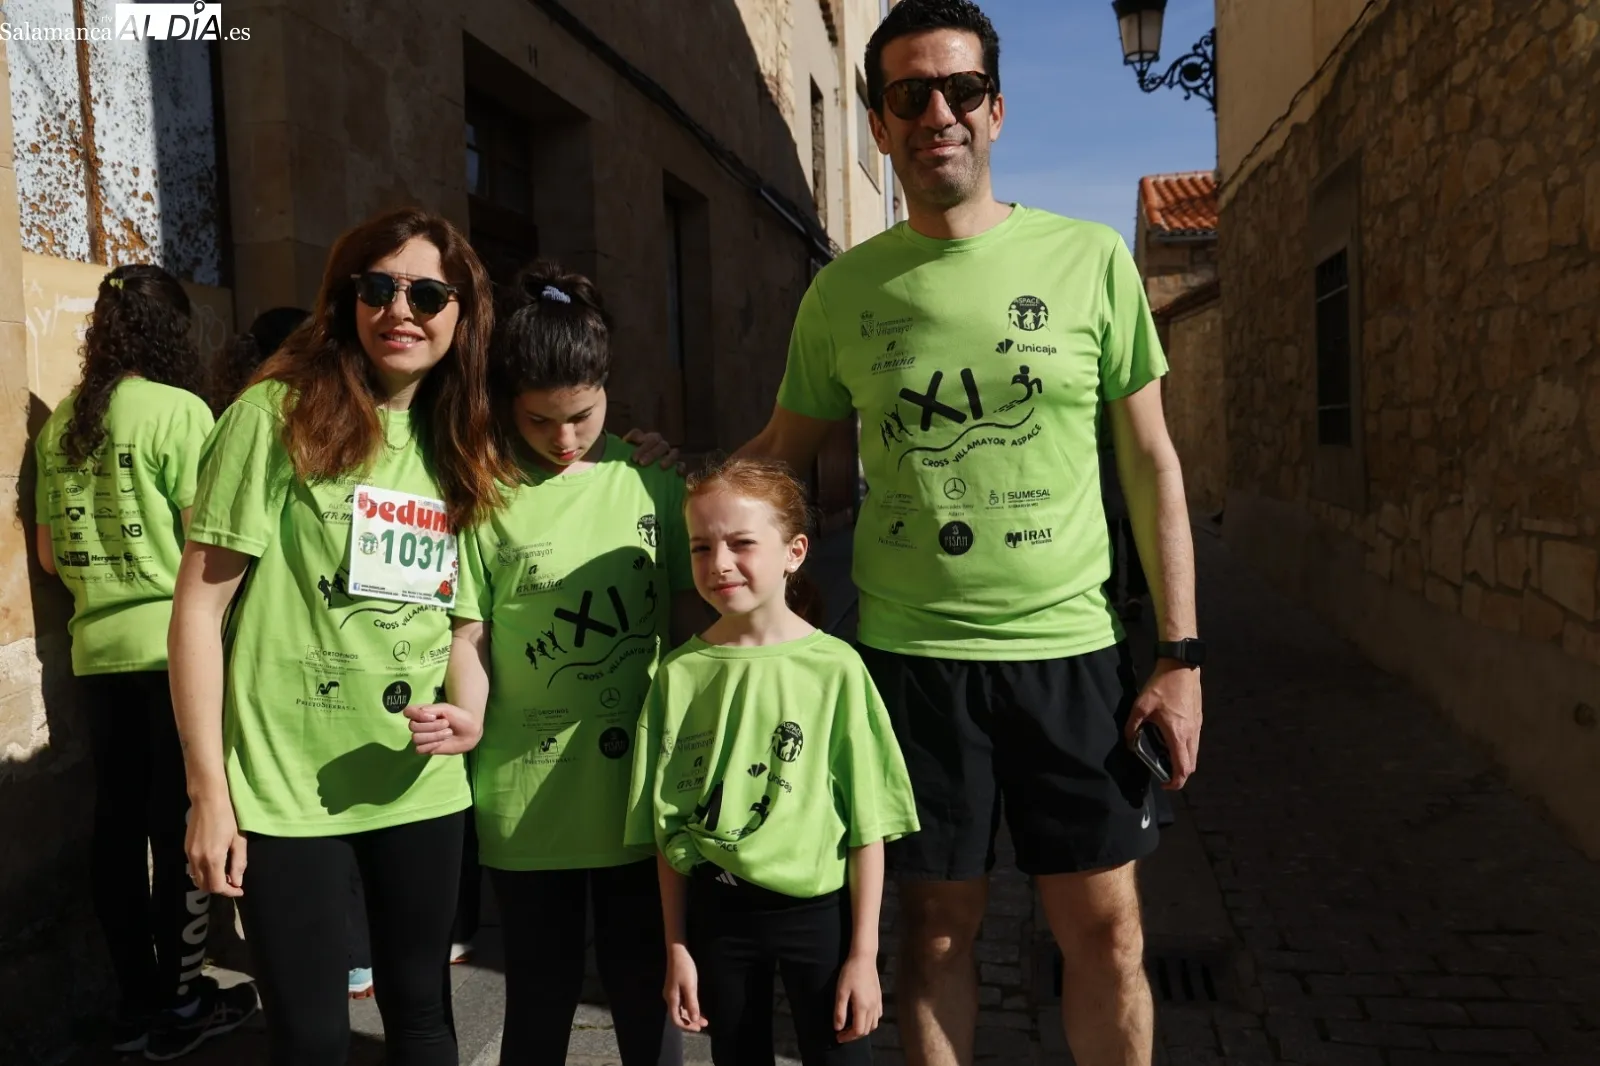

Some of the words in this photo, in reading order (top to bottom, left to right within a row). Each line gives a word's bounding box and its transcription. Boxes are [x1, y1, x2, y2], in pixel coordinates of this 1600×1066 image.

[1016, 342, 1058, 356] Unicaja
[899, 367, 984, 432] XI
[922, 457, 949, 468] CROSS
[952, 437, 1006, 464] VILLAMAYOR
[1010, 423, 1042, 448] ASPACE
[1007, 489, 1051, 500] SUMESAL
[380, 528, 446, 573] 1031
[373, 618, 399, 630] CROSS
[553, 585, 630, 648] XI
